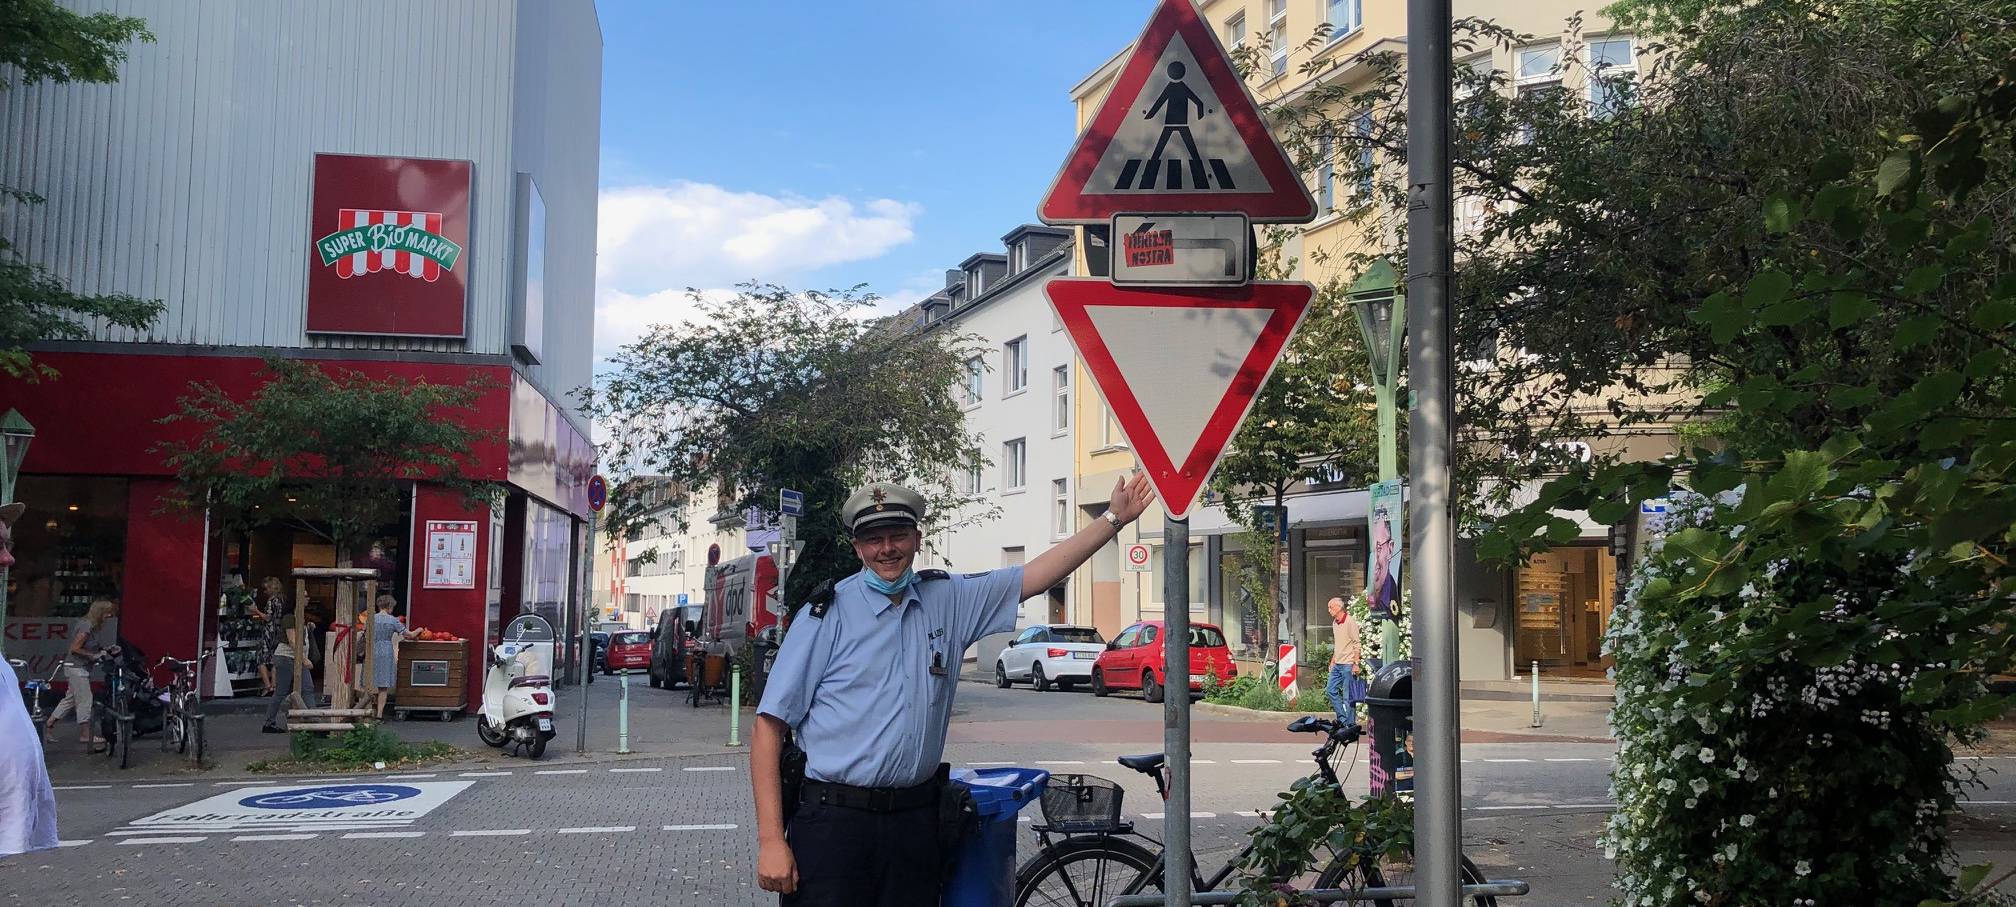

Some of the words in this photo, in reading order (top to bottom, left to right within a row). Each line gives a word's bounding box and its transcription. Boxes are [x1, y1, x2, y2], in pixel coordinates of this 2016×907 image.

[324, 231, 367, 258] SUPER
[367, 223, 414, 255] Bio
[404, 231, 454, 262] MARKT
[1132, 248, 1172, 265] NOSTRA
[1133, 550, 1144, 560] 30
[153, 809, 416, 822] Fahrradstraße
